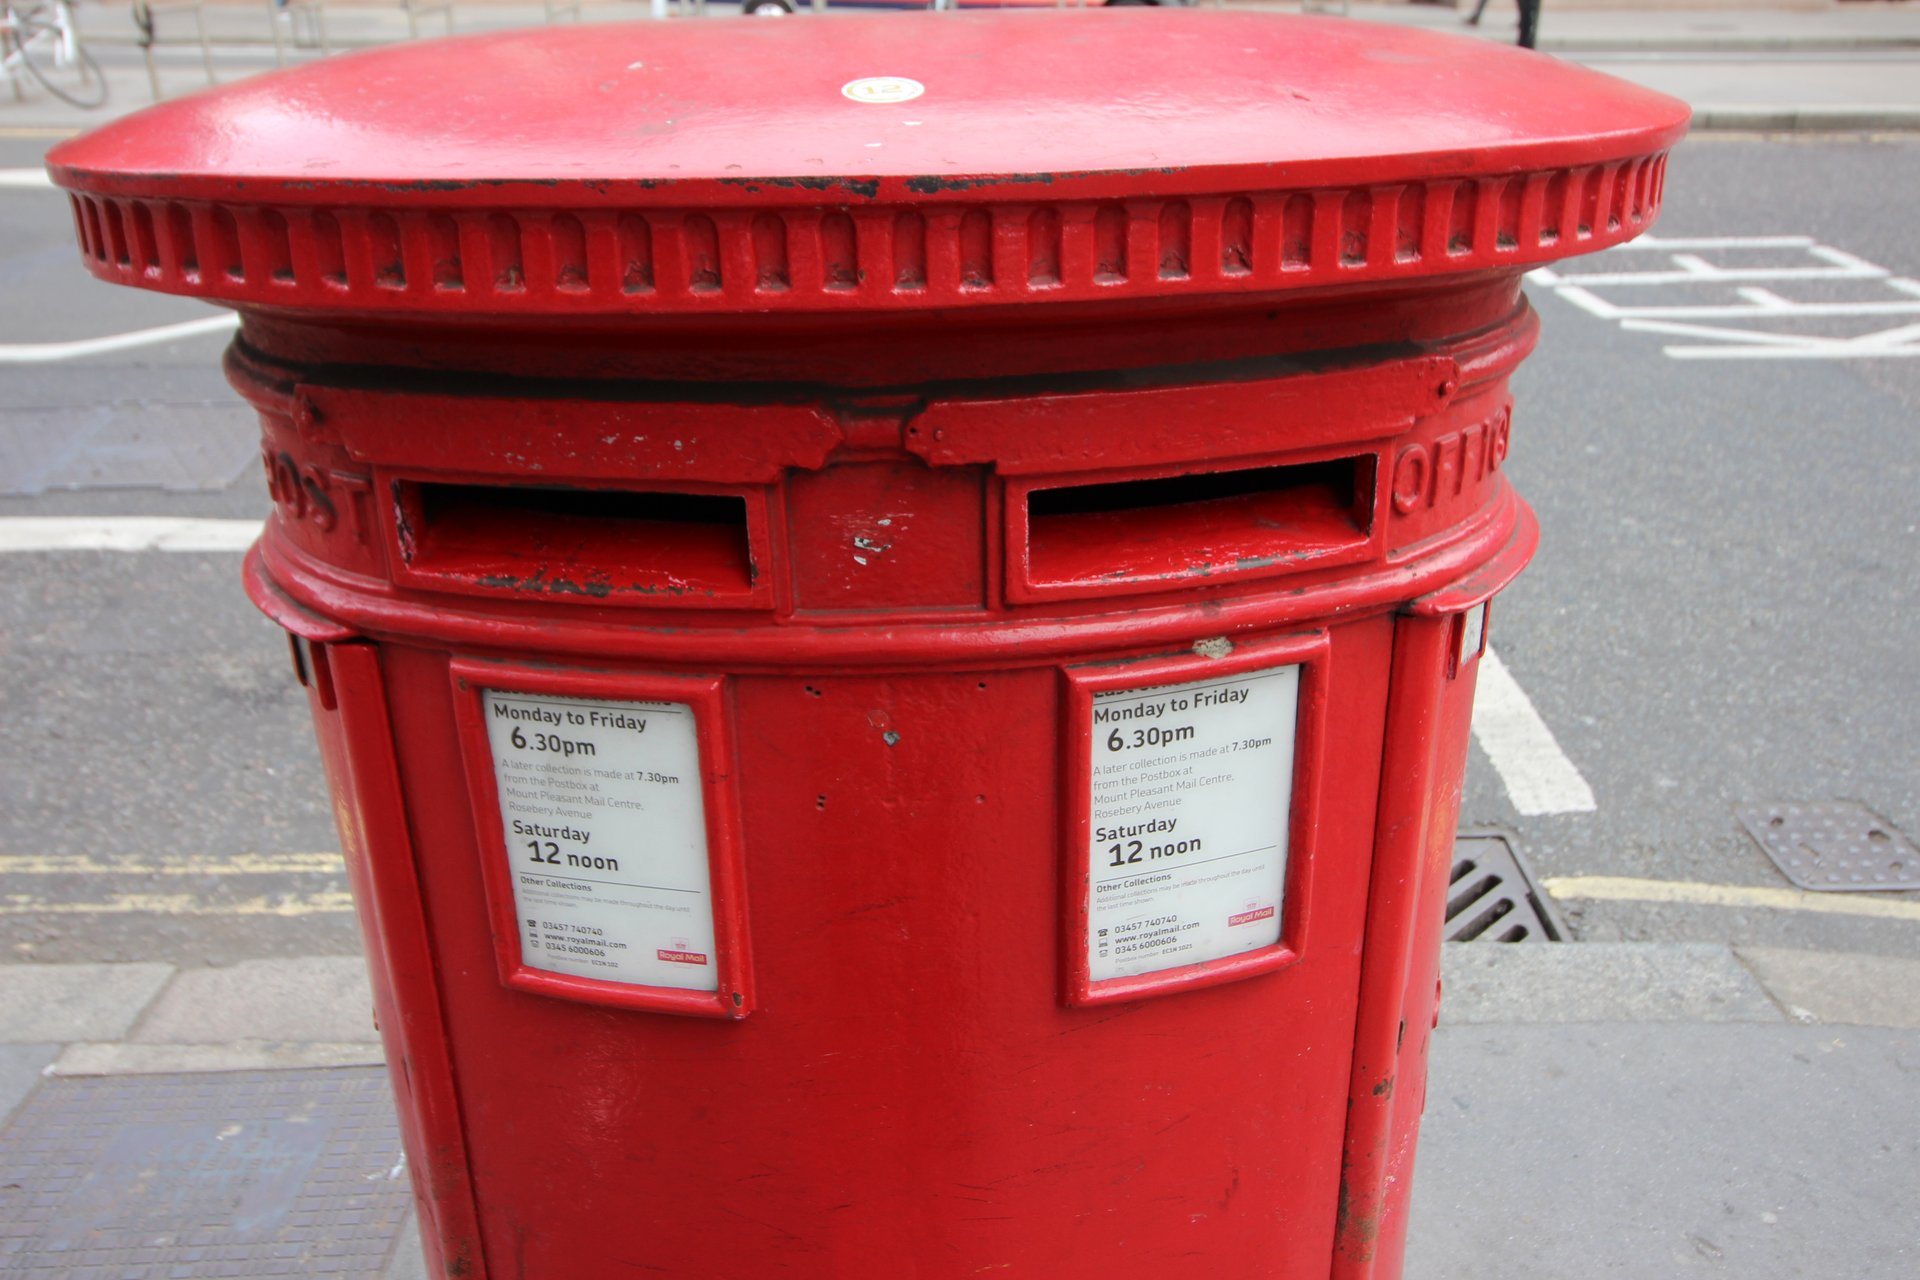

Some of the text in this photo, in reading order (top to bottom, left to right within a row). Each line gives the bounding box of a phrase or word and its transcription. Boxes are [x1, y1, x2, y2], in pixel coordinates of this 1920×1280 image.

[1392, 405, 1512, 516] OFFIC
[494, 704, 646, 732] Monday to Friday
[1094, 703, 1165, 724] Monday
[1171, 696, 1188, 710] to
[1194, 688, 1249, 708] Friday
[511, 726, 596, 756] 6.30pm
[1108, 726, 1194, 751] 6.30pm
[1093, 737, 1271, 776] A later collection is made at 7.30pm
[502, 759, 679, 784] A later collection is made at 7.30pm
[504, 774, 599, 791] from the Postbox at
[1093, 766, 1193, 790] from the Postbox at
[507, 788, 537, 799] Mount
[540, 791, 583, 804] Pleasant
[585, 794, 604, 806] Mail
[1094, 792, 1127, 805] Mount
[1130, 784, 1173, 798] Pleasant
[1176, 779, 1197, 790] Mail
[509, 801, 592, 819] Rosebery Avenue
[1094, 798, 1182, 819] Rosebery Avenue
[513, 820, 590, 844] Saturday
[1096, 818, 1177, 842] Saturday
[528, 840, 618, 871] 12 noon
[1109, 838, 1200, 867] 12 noon
[521, 876, 592, 891] Other Collections
[1097, 873, 1171, 893] Other Collections
[1115, 915, 1177, 933] 03457 740740
[1230, 908, 1272, 924] Royal Mail
[544, 933, 626, 949] www.royalmail.com
[1115, 921, 1200, 944] www.royalmail.com
[1115, 935, 1177, 954] 0345 6000606
[659, 951, 705, 962] Royal Mail
